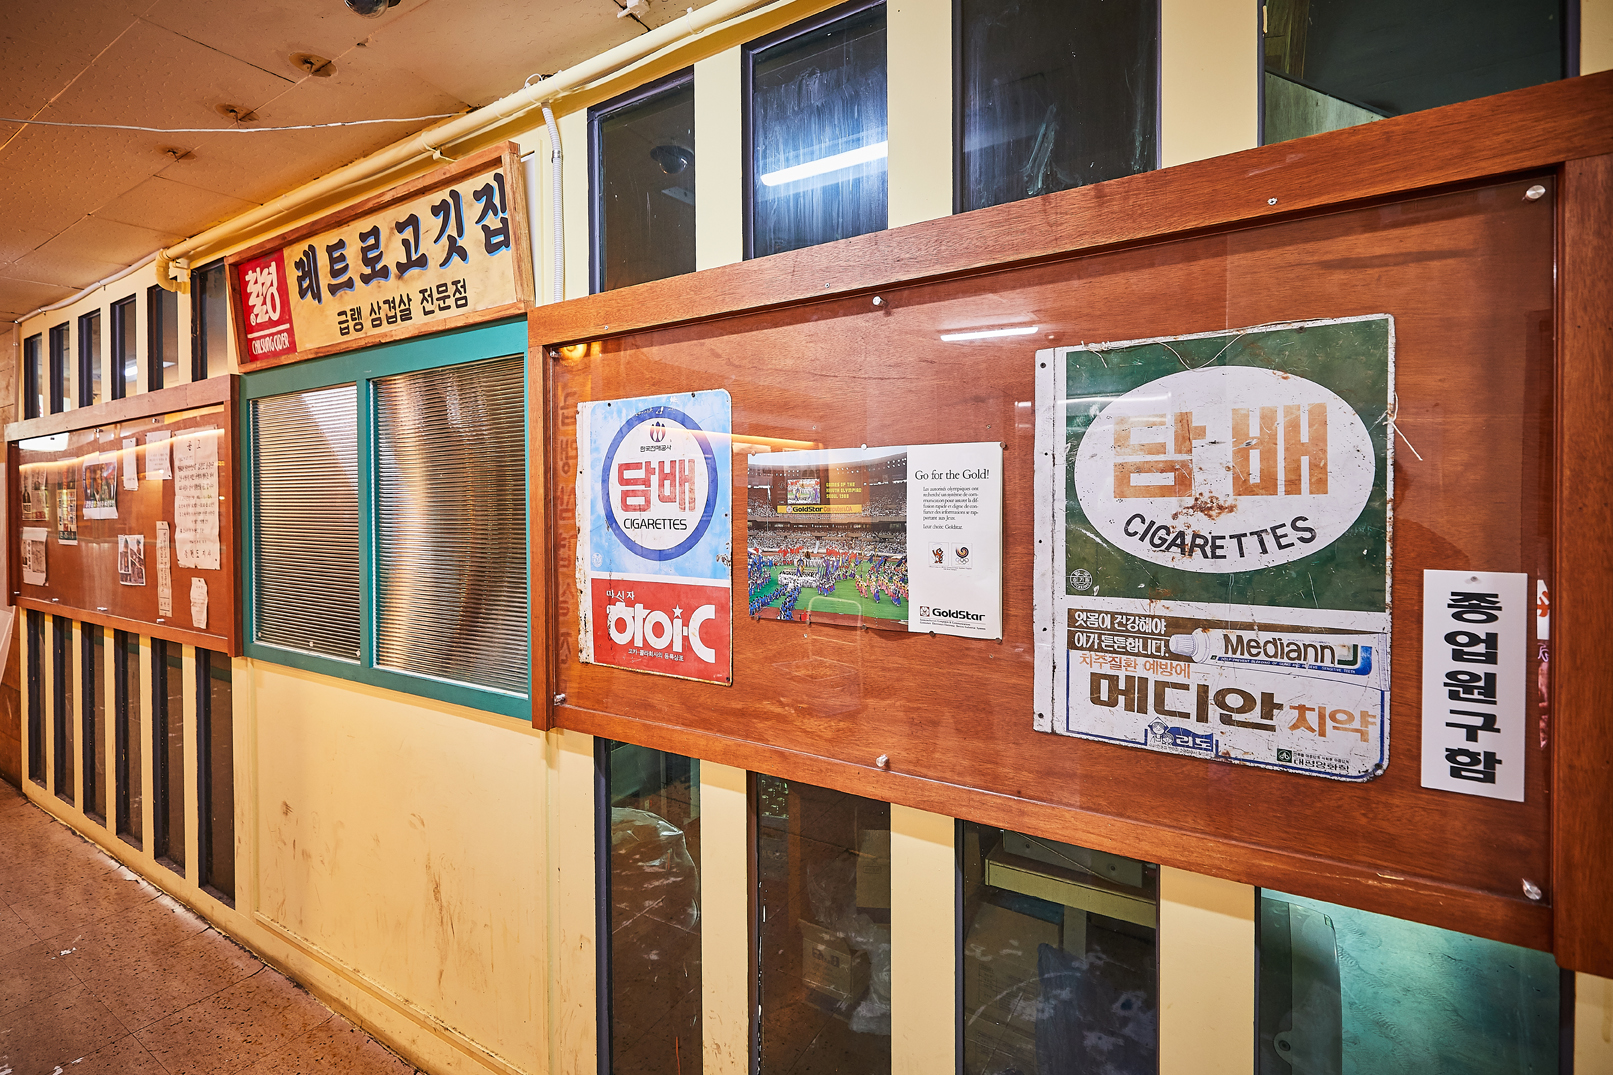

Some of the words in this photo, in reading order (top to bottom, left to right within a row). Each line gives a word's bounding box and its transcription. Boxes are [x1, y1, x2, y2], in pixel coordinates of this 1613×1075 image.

[294, 172, 512, 305] 레트로고깃집
[337, 305, 364, 337] 급랭
[369, 292, 413, 329] 삼겹살
[418, 278, 468, 316] 전문점
[273, 332, 290, 352] CIDER
[1113, 402, 1329, 499] 담배
[617, 458, 696, 513] 담배
[914, 470, 929, 480] Go
[931, 470, 944, 480] for
[946, 470, 960, 480] the
[962, 468, 990, 480] Gold!
[623, 518, 688, 531] CIGARETTES
[1123, 513, 1317, 560] CIGARETTES
[932, 608, 986, 621] GoldStar
[1075, 611, 1111, 629] 잇몸이
[1114, 614, 1166, 634] 건강해야
[1074, 632, 1099, 649] 이가
[1101, 634, 1169, 657] 튼튼합니다.
[1080, 652, 1138, 672] 치주질환
[1144, 659, 1190, 680] 예방에
[1443, 591, 1503, 784] 종업원구함
[1089, 671, 1284, 733] 메디안
[1288, 703, 1378, 743] 치약
